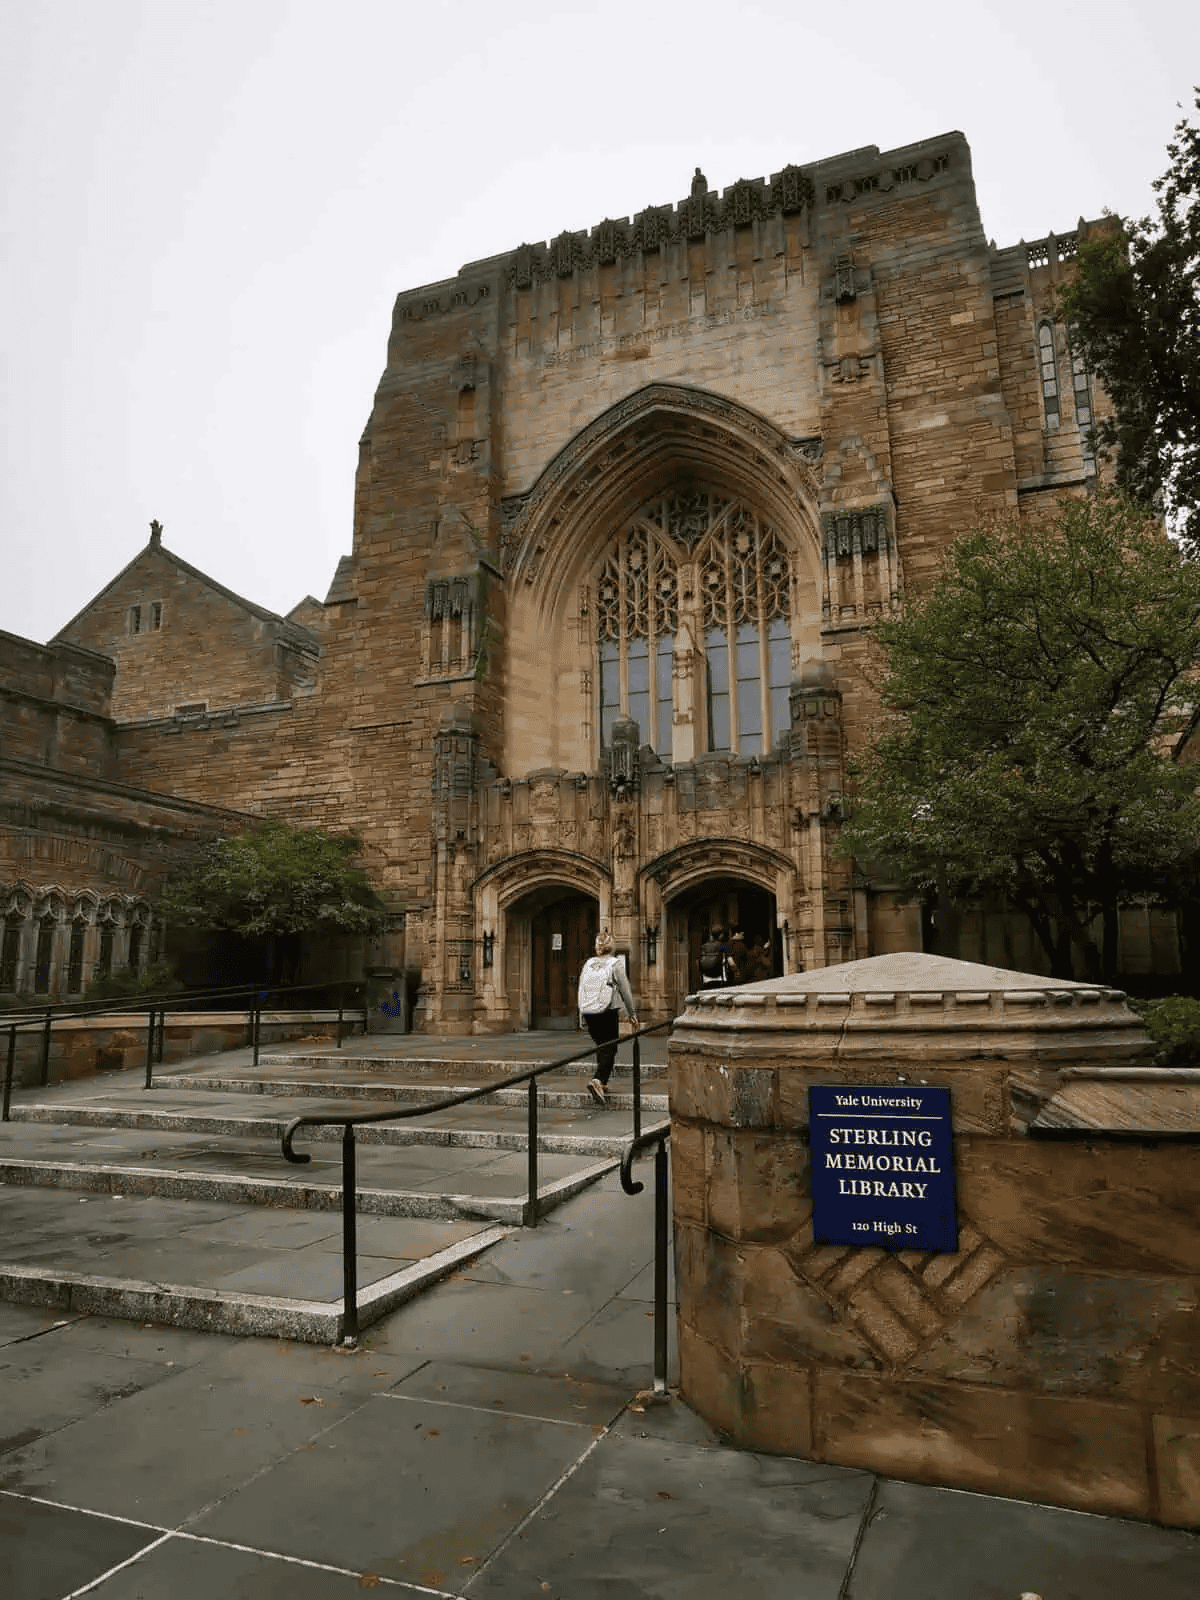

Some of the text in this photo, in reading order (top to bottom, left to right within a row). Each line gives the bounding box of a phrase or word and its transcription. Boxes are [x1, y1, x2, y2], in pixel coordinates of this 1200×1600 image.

[834, 1095, 923, 1111] Yale University
[829, 1128, 933, 1147] STERLING
[825, 1153, 941, 1173] MEMORIAL
[838, 1179, 928, 1198] LIBRARY
[852, 1221, 918, 1236] 120 High St
